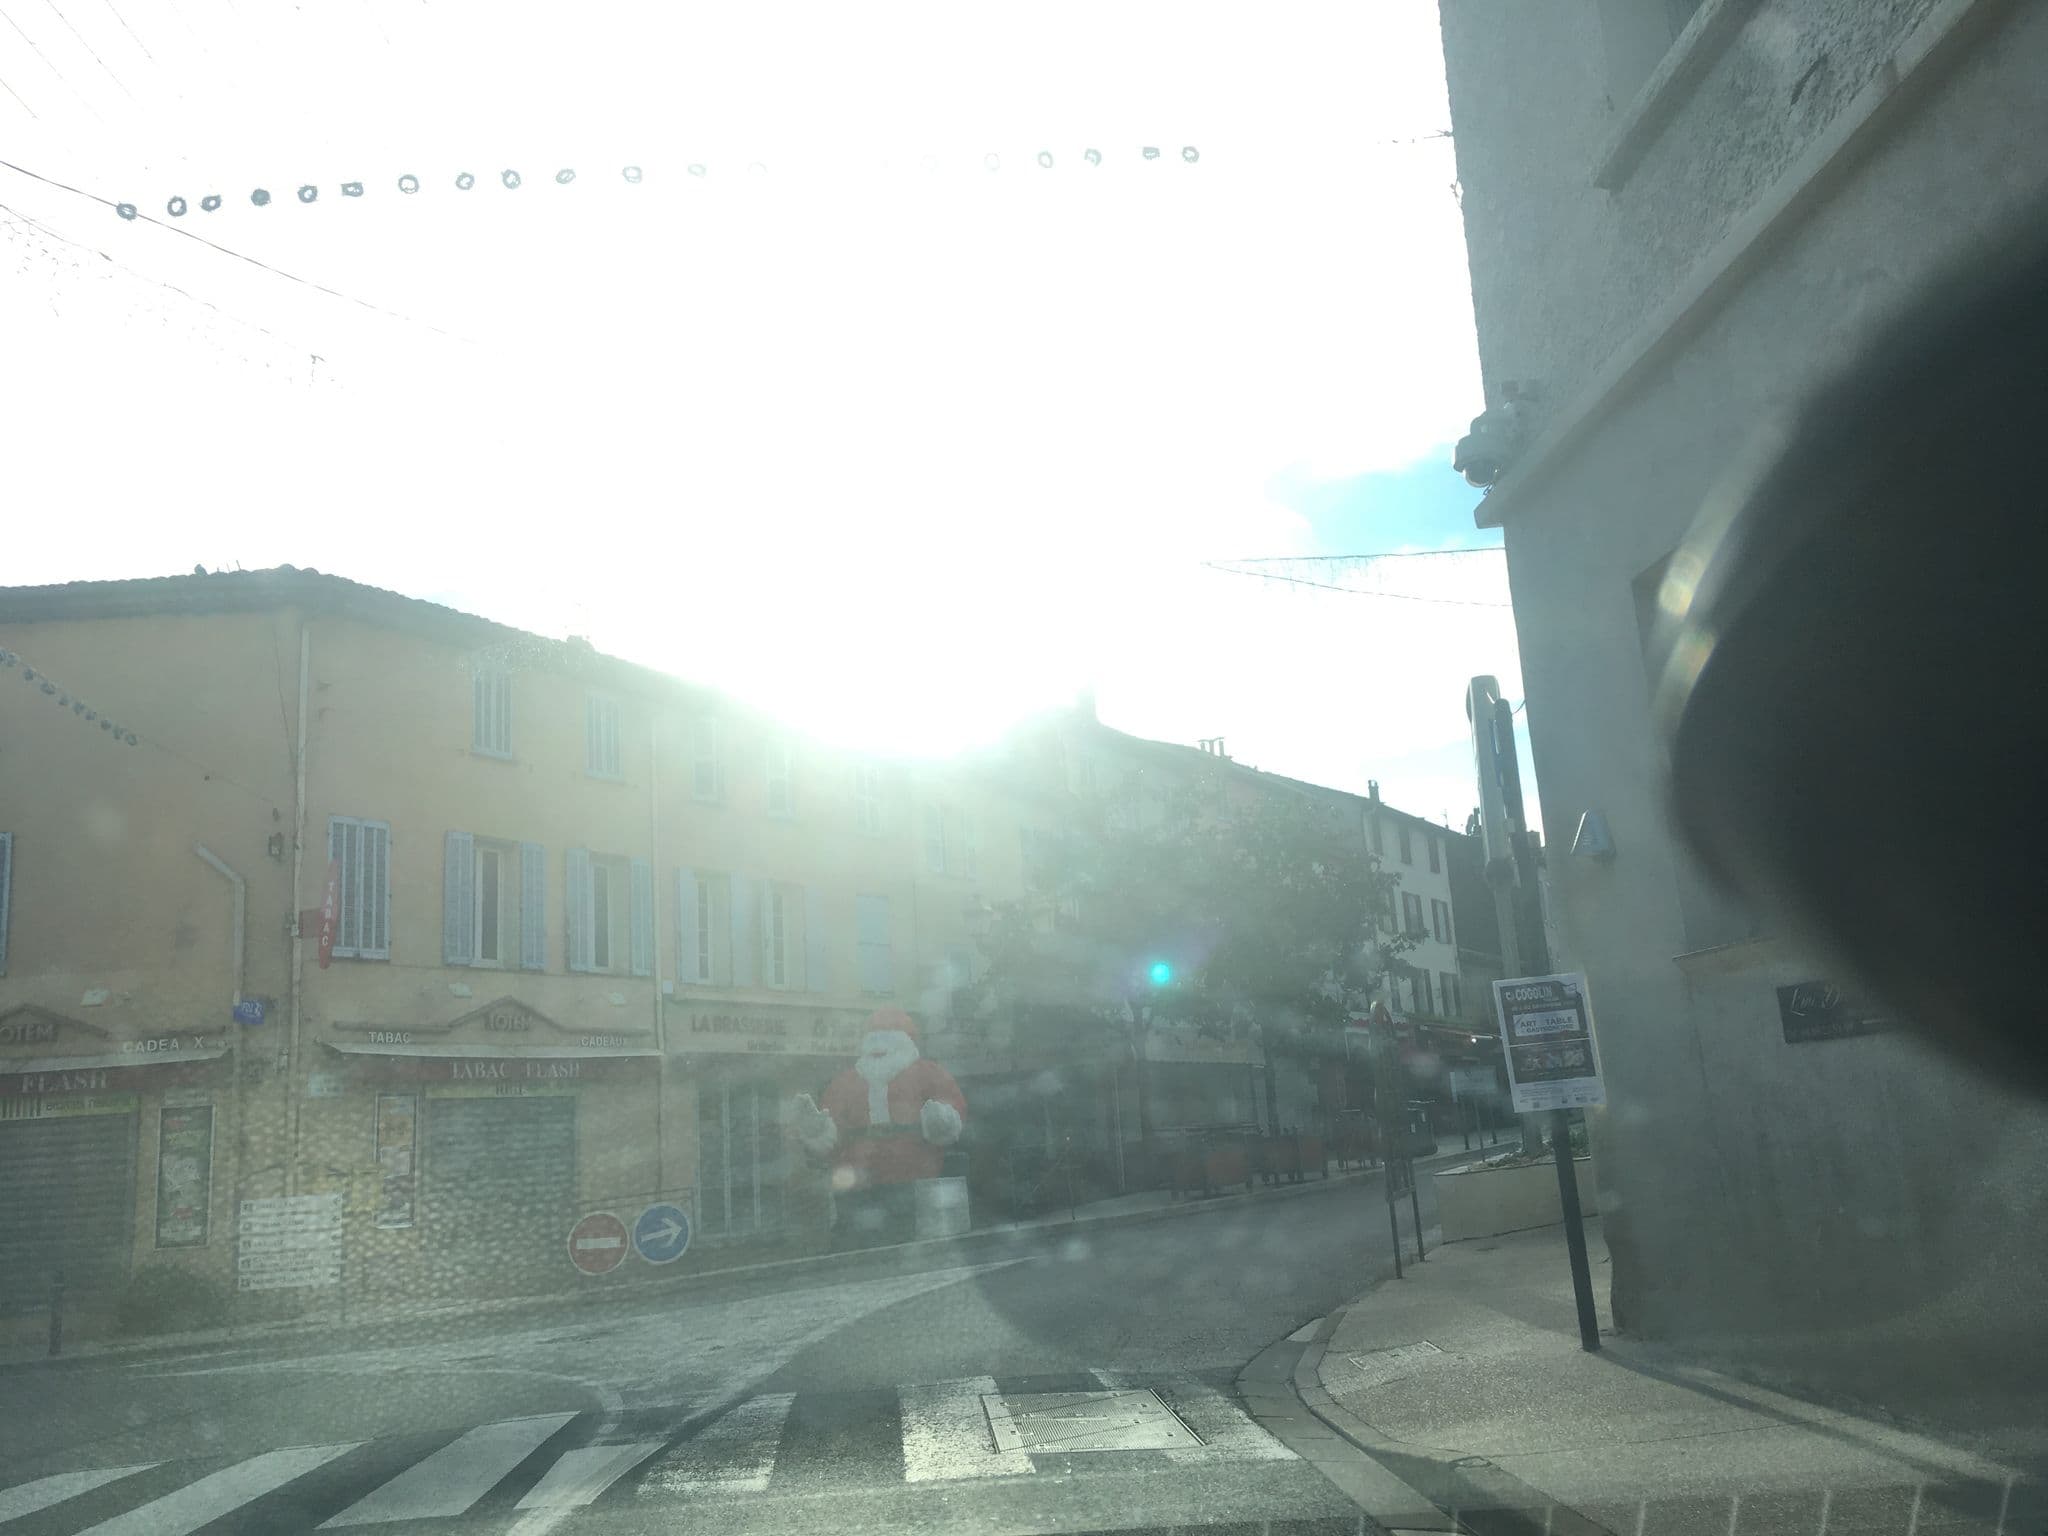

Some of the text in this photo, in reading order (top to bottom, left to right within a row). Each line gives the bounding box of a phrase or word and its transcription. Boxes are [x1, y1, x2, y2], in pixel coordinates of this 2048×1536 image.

[322, 881, 335, 946] TABAC
[1515, 985, 1553, 1001] COGOLIN
[1520, 1019, 1537, 1029] ART
[368, 1031, 411, 1045] TABAC
[451, 1061, 580, 1079] TABAC FLASH
